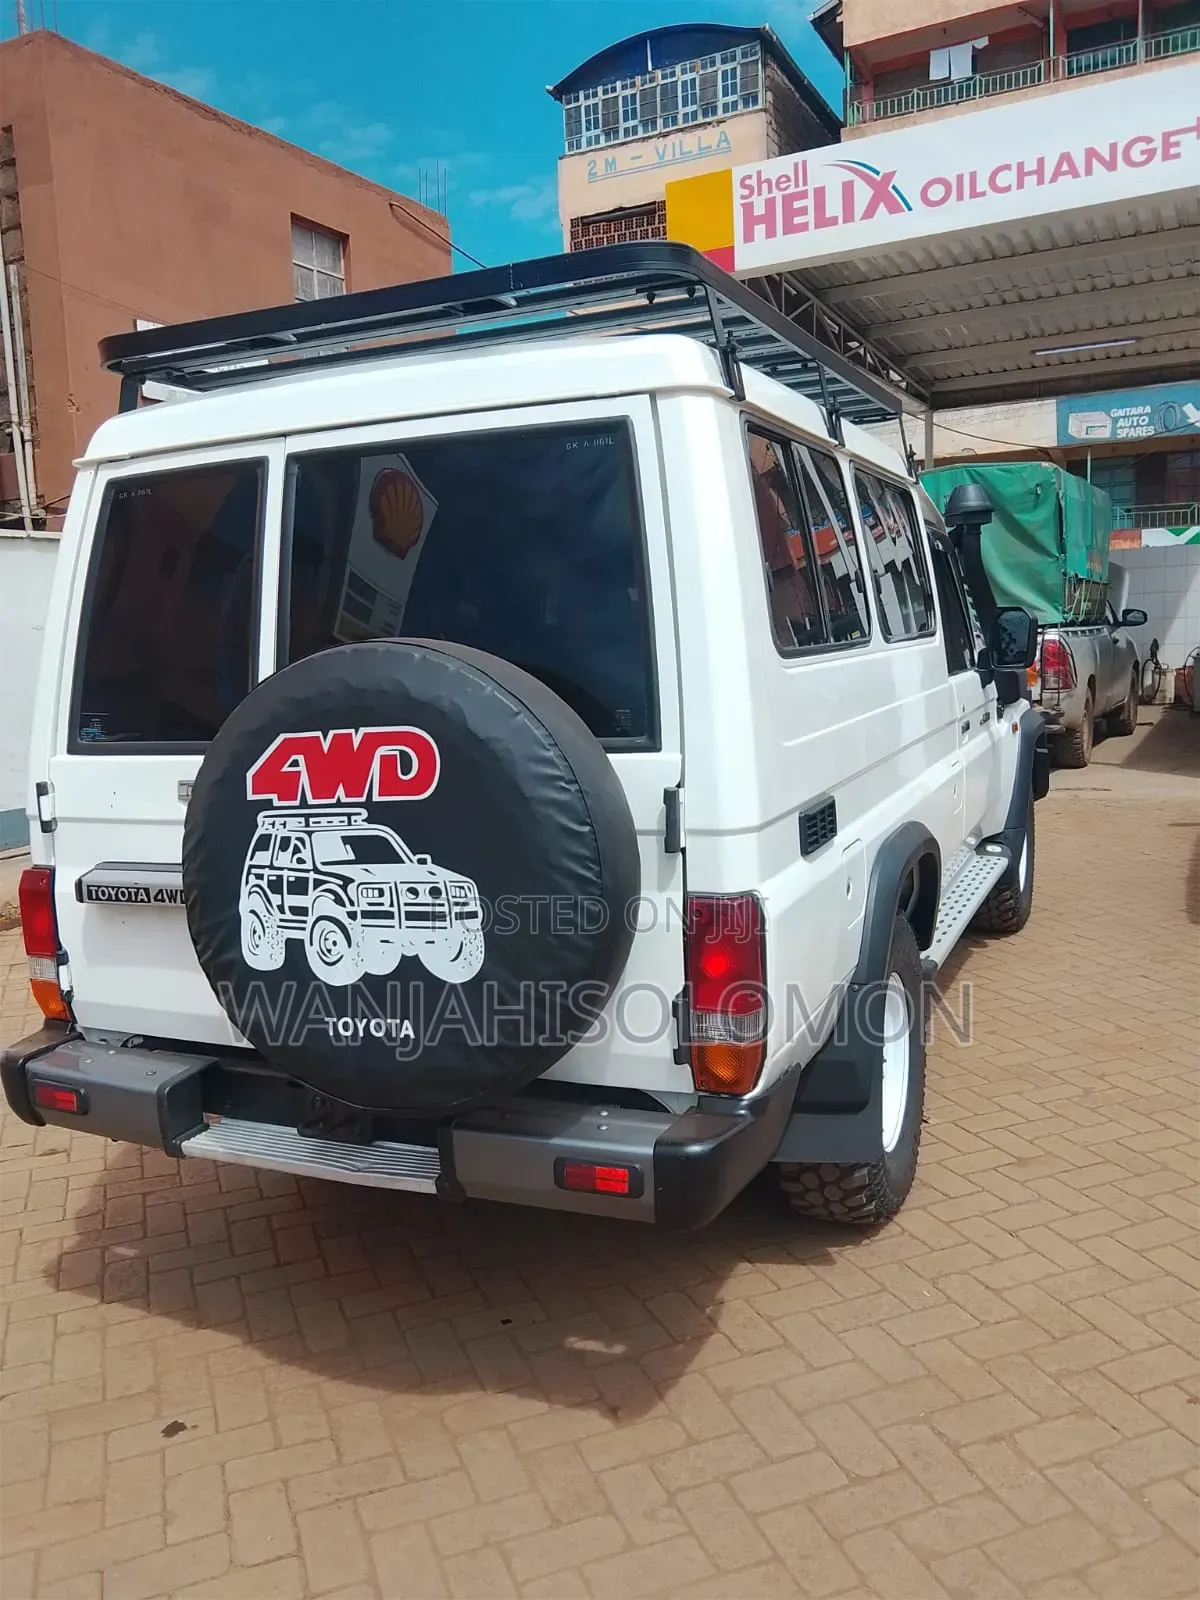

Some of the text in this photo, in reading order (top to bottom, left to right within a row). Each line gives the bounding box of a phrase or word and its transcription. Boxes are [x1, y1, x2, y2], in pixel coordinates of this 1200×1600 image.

[655, 130, 732, 162] VILLA
[739, 159, 809, 201] Shell
[740, 166, 910, 244] HELIX
[1116, 415, 1149, 427] AUTO
[1116, 426, 1155, 438] SPARES
[246, 725, 441, 806] 4WD
[89, 886, 149, 902] TOYOTA
[324, 1016, 415, 1039] TOYOTA
